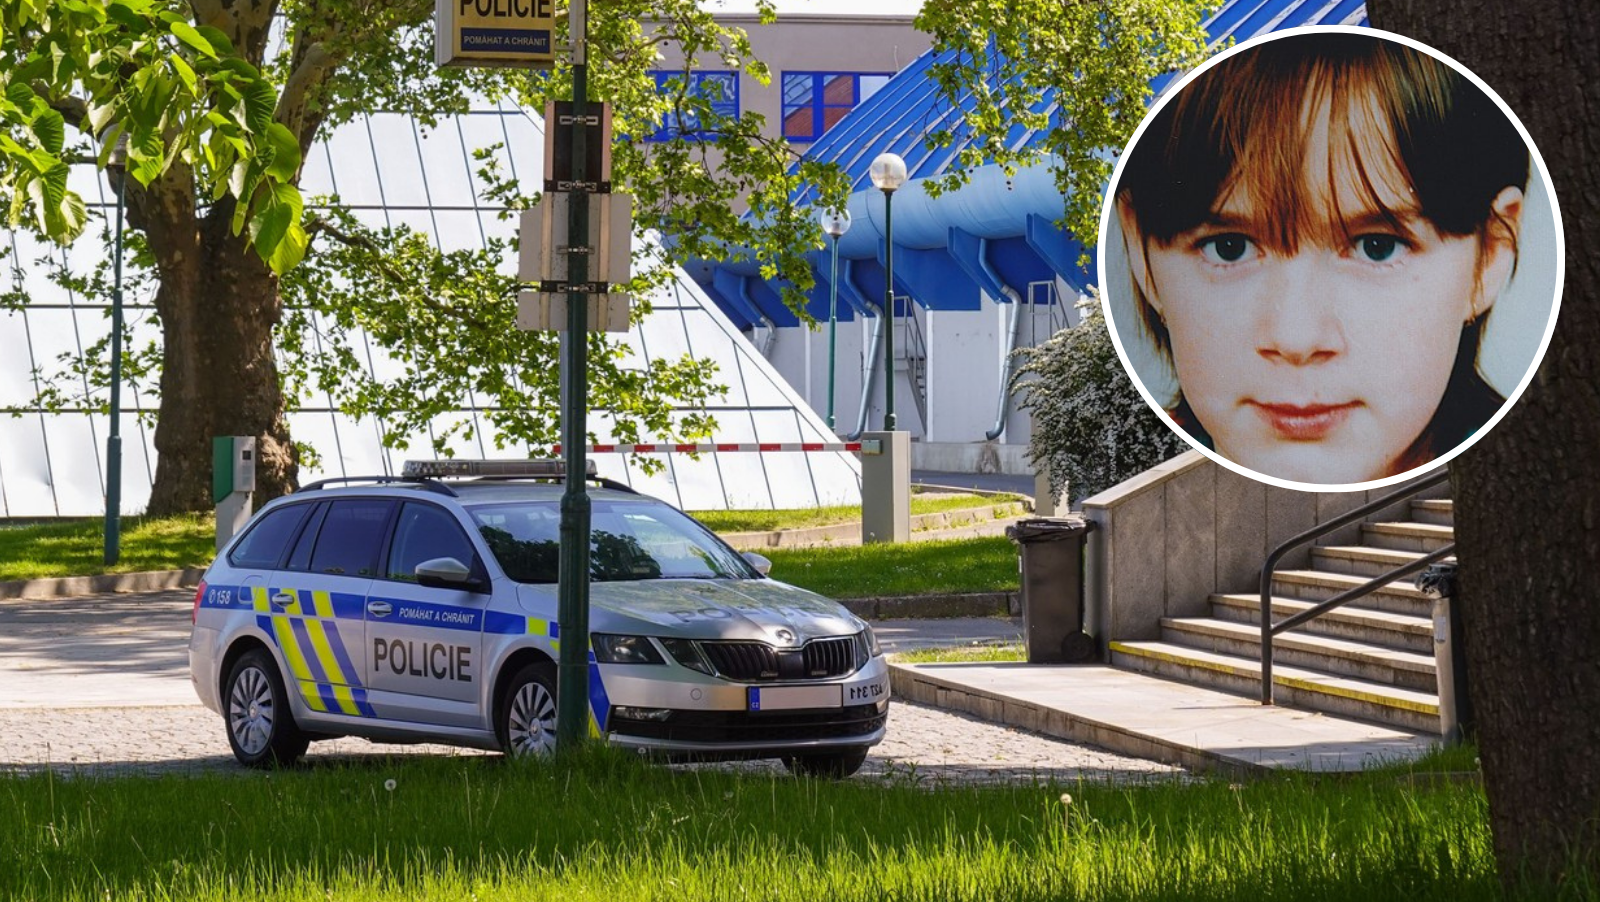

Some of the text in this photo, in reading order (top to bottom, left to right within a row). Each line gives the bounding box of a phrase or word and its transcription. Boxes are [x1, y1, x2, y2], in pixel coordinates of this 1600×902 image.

[460, 0, 551, 18] POLICIE
[464, 35, 547, 46] POMÁHAT A CHRÁNIT
[216, 590, 231, 605] 158
[398, 606, 475, 625] POMÁHAT A CHRÁNIT
[374, 637, 472, 682] POLICIE
